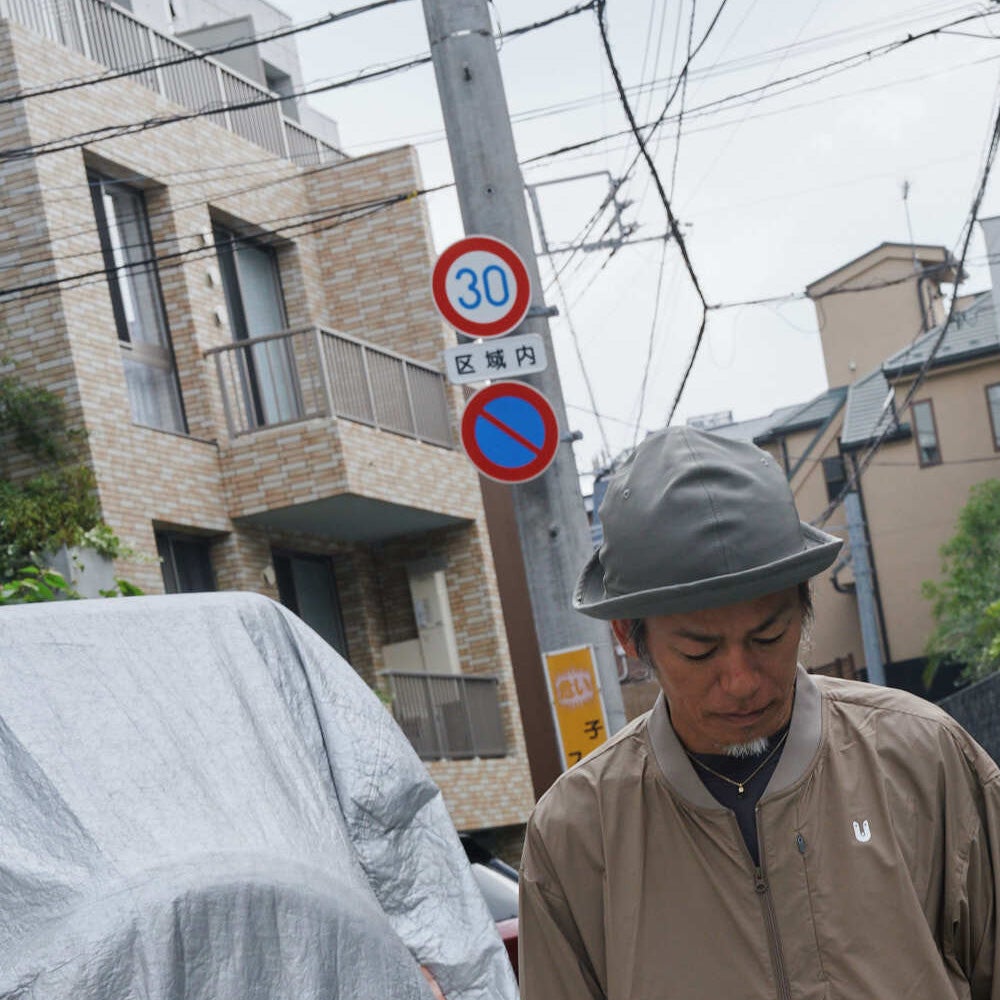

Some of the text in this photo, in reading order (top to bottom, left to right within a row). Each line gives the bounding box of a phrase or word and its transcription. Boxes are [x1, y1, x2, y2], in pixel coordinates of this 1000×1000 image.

[456, 265, 509, 309] 30
[456, 346, 536, 375] 区域内
